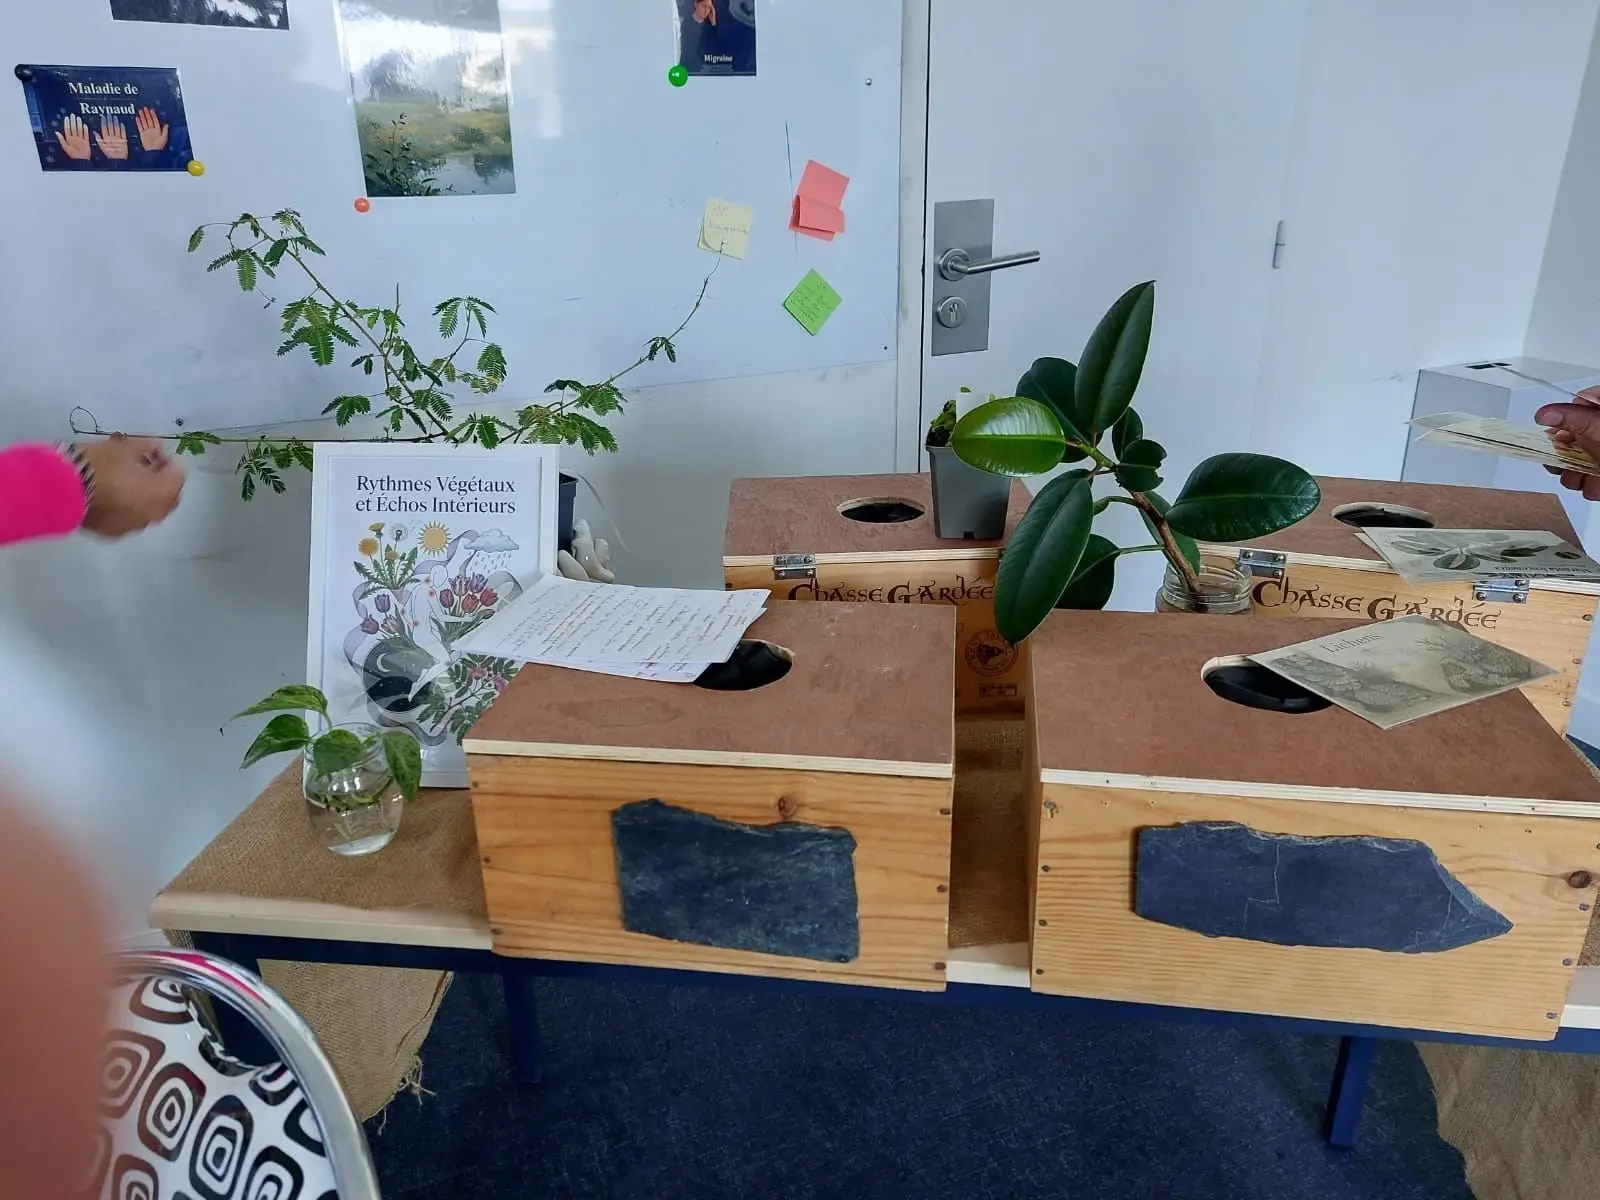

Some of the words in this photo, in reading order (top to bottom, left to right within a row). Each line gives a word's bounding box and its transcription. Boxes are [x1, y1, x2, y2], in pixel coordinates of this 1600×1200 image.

[704, 54, 733, 63] Migraine
[68, 82, 121, 95] Maladie
[123, 83, 139, 95] de
[79, 102, 136, 117] Raynaud
[356, 475, 432, 494] Rythmes
[436, 475, 516, 496] Végétaux
[355, 497, 372, 512] et
[376, 493, 428, 512] Échos
[432, 496, 516, 514] Intérieurs
[1319, 632, 1384, 653] Lichens
